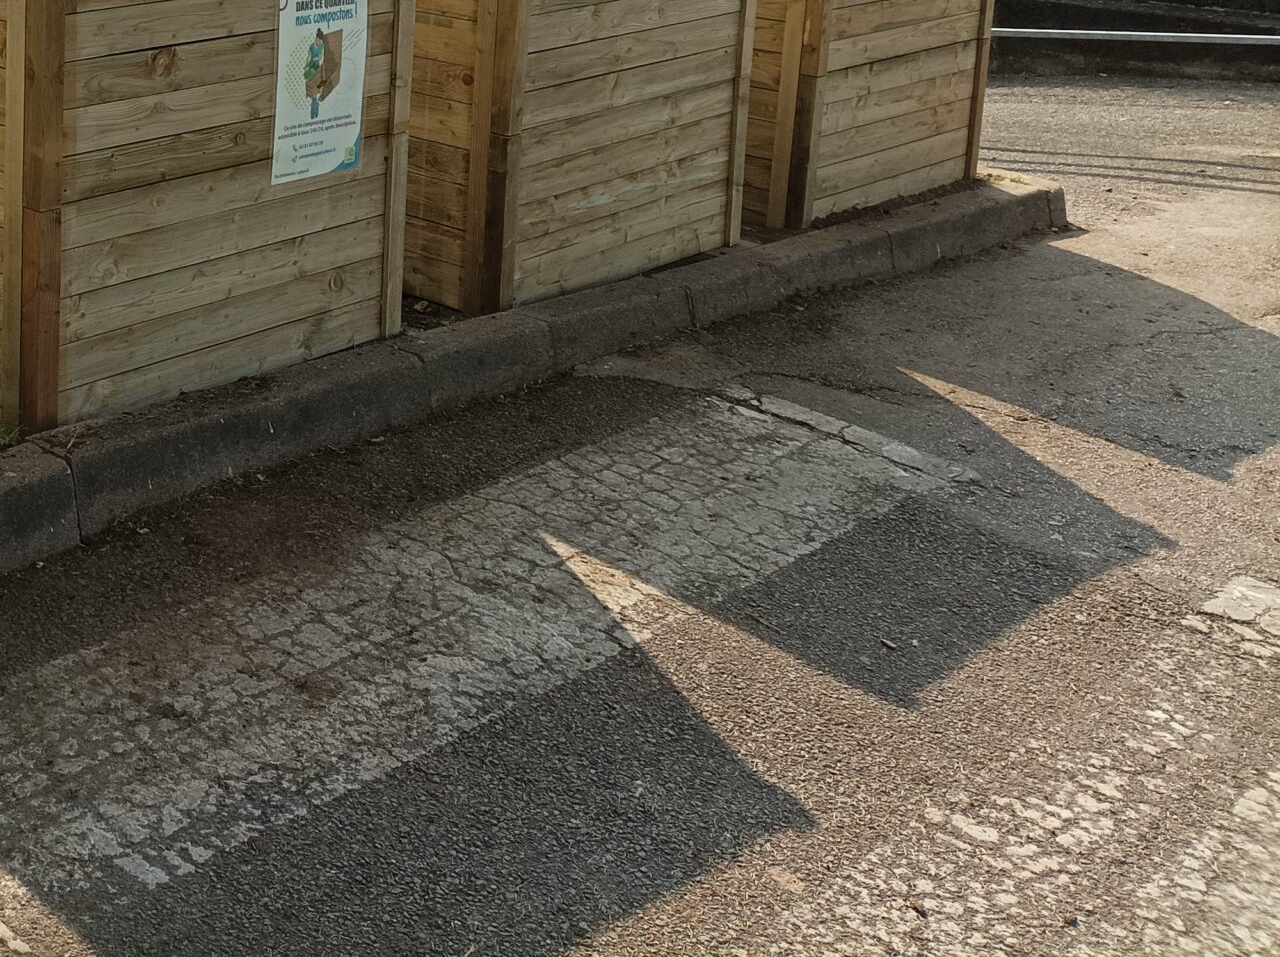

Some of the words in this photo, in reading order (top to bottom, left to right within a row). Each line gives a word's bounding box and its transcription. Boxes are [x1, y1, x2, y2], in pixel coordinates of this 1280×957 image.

[296, 0, 314, 12] DANS
[296, 14, 312, 26] nous
[313, 8, 353, 29] compostons
